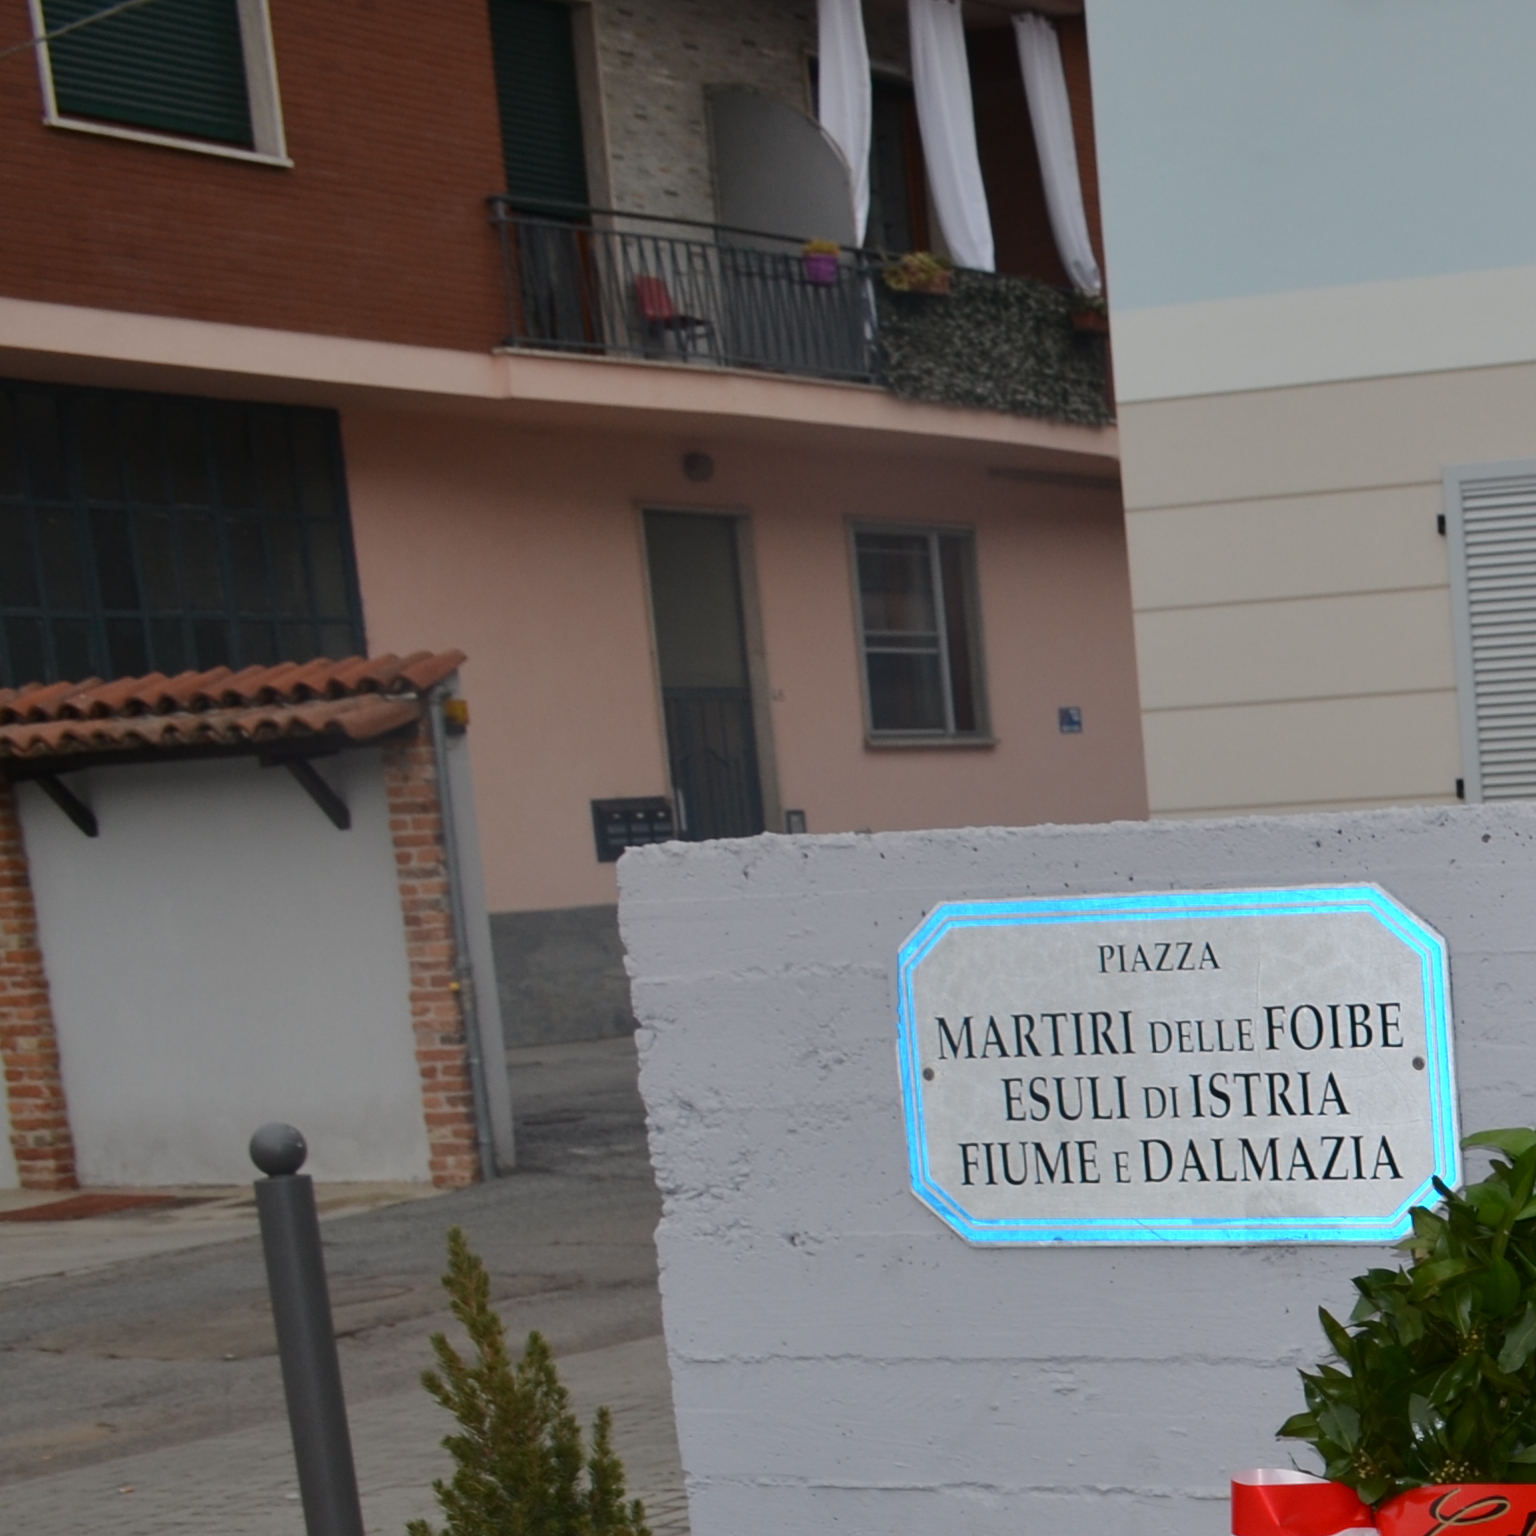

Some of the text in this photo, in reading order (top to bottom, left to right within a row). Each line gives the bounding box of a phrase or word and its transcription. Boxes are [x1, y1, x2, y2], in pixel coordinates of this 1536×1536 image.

[1097, 941, 1221, 974] PIAZZA
[934, 1002, 1404, 1060] MARTIRI DELLE FOIBE
[1000, 1071, 1351, 1122] ESULI DI ISTRIA
[957, 1134, 1404, 1186] FIUME E DALMAZIA
